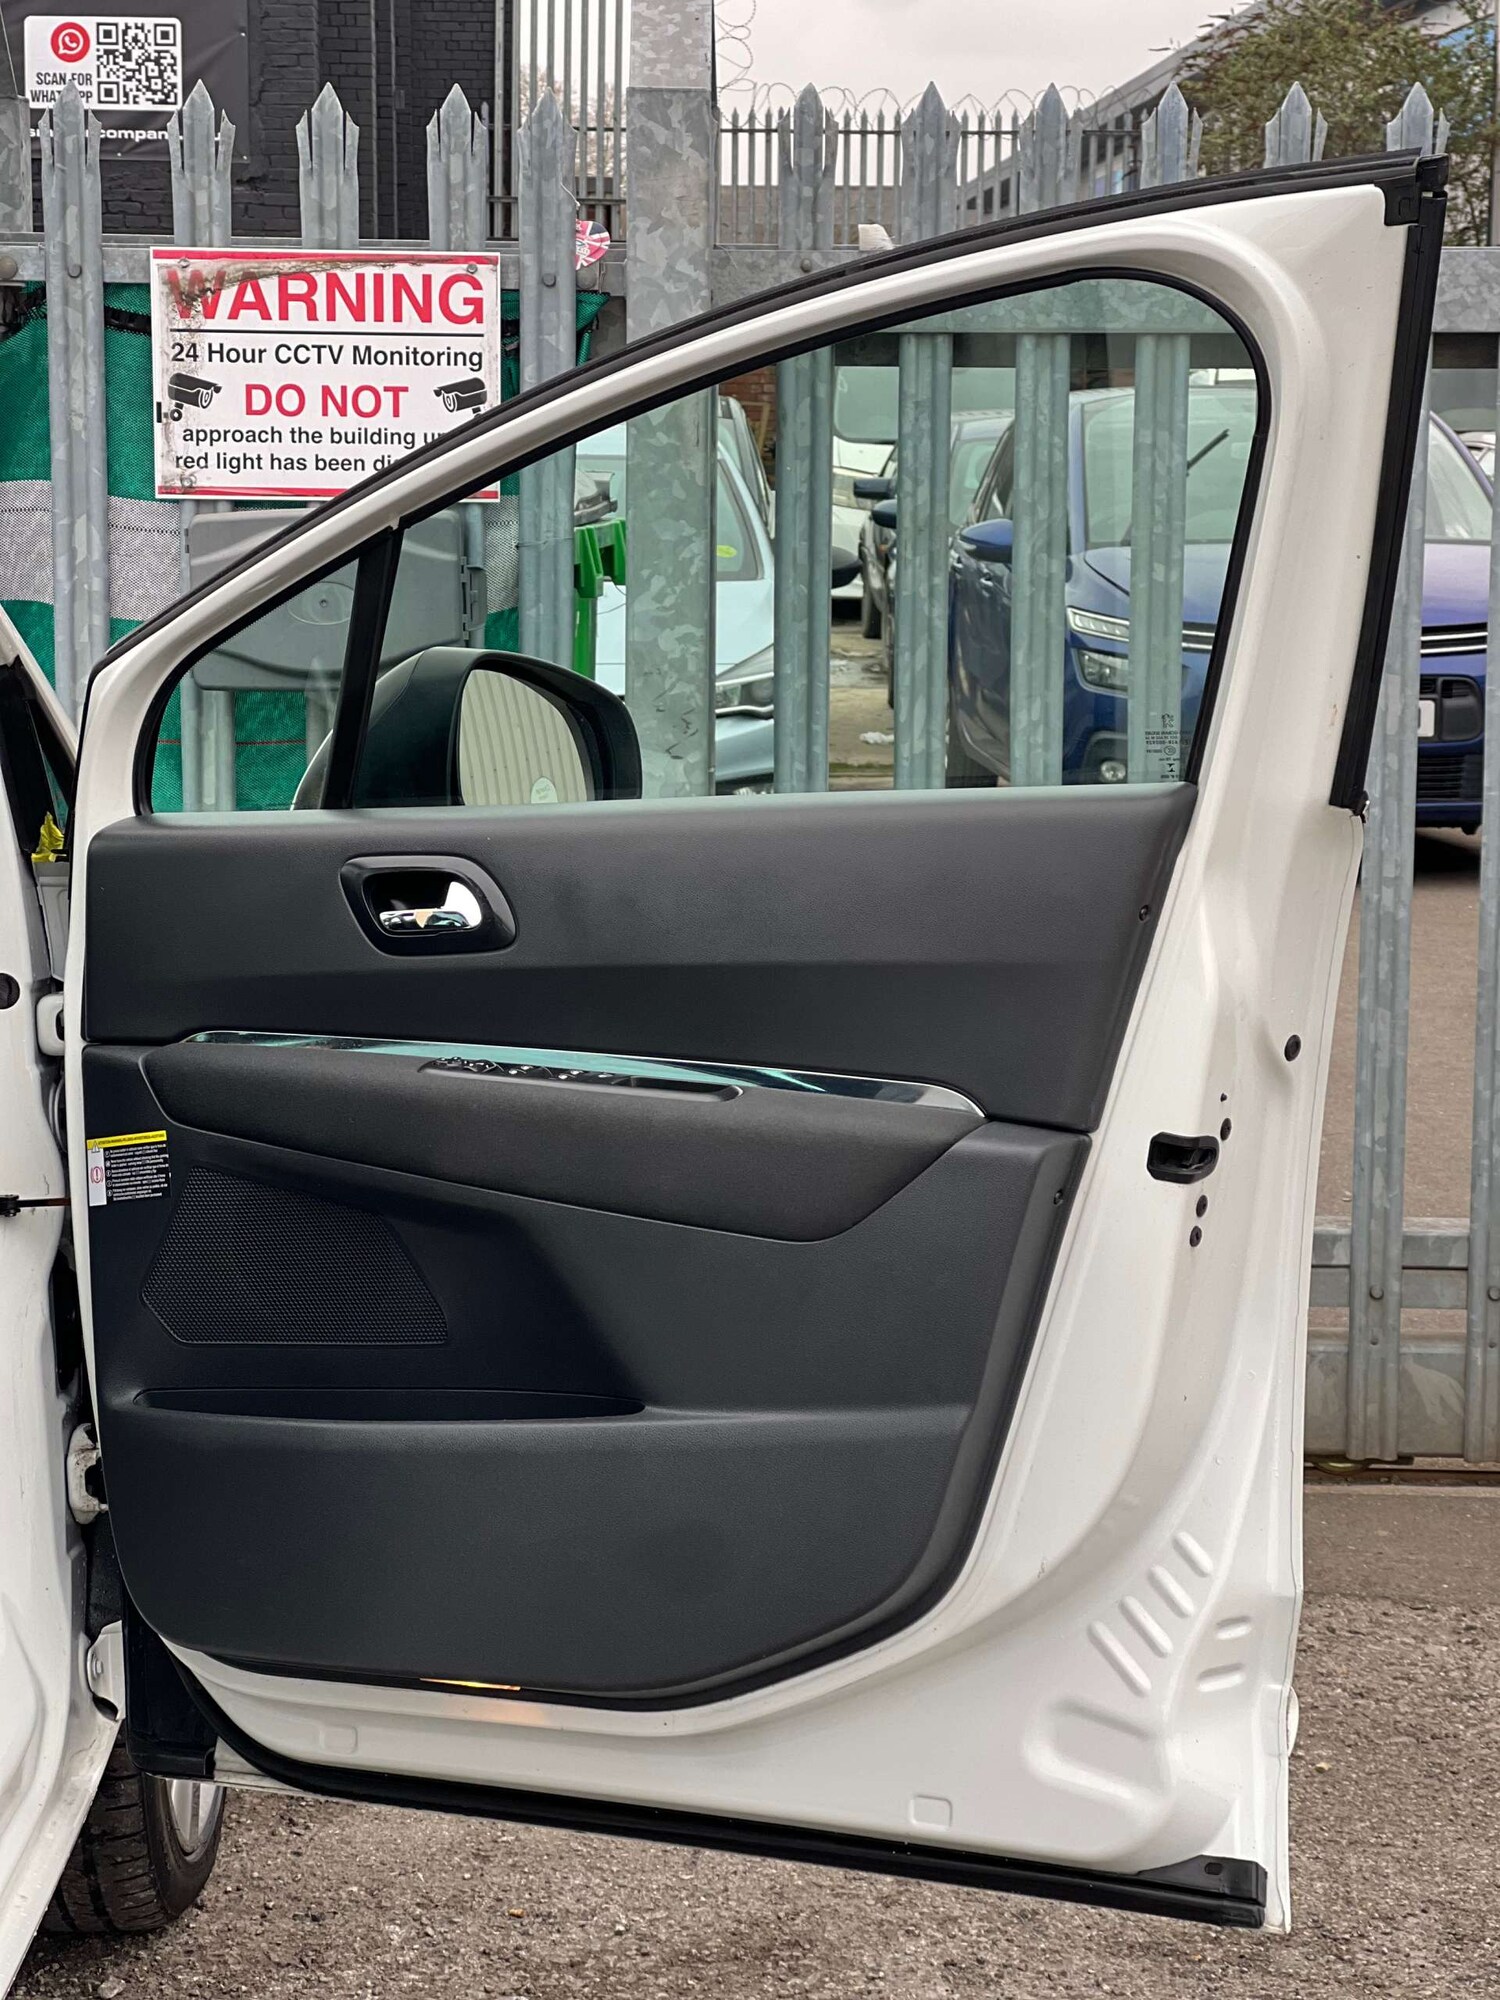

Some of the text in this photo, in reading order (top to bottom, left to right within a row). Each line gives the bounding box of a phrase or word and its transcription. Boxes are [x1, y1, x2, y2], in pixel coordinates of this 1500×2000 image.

[36, 72, 92, 86] SCAN FOR
[30, 90, 93, 103] WHAPP
[166, 268, 484, 325] WARNING
[171, 342, 483, 372] 24 Hour CCTV Monitoring
[245, 383, 409, 418] DO NOT
[182, 426, 282, 447] approach
[289, 426, 323, 444] the
[330, 426, 416, 449] building
[175, 452, 209, 469] red
[216, 452, 263, 474] light
[270, 453, 307, 471] has
[315, 454, 366, 471] been
